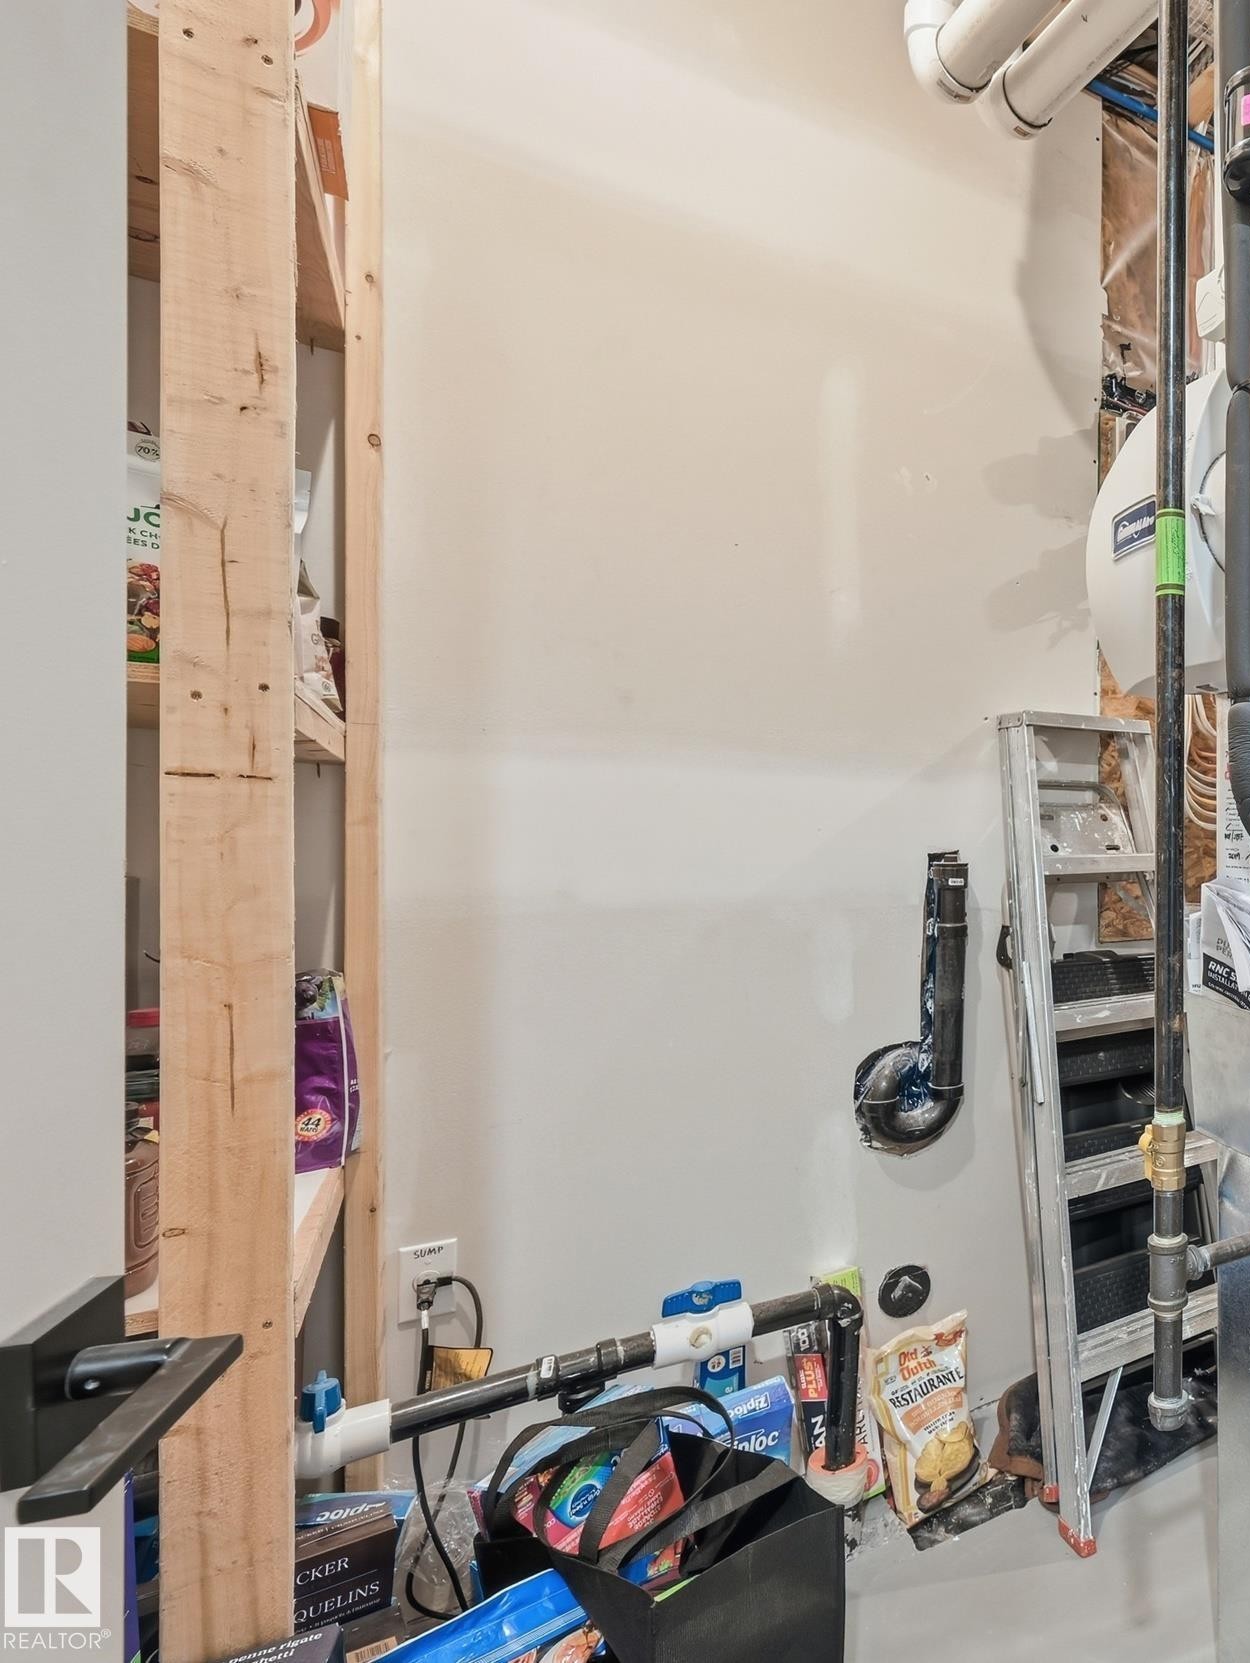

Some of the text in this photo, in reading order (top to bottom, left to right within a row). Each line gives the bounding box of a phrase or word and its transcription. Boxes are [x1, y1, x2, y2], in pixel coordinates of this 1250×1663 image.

[1208, 960, 1230, 977] RNC
[302, 1117, 322, 1128] 44
[413, 1245, 444, 1259] SUMP
[899, 1348, 918, 1368] Old
[802, 1360, 818, 1399] PLUS
[900, 1358, 937, 1382] Dutch
[889, 1366, 964, 1409] RESTAURANTE
[726, 1394, 768, 1418] Ziploc
[724, 1430, 780, 1452] iploc
[315, 1501, 369, 1522] ploc
[296, 1557, 330, 1586] CKER
[294, 1580, 380, 1624] QUELINS
[280, 1632, 323, 1650] rigate
